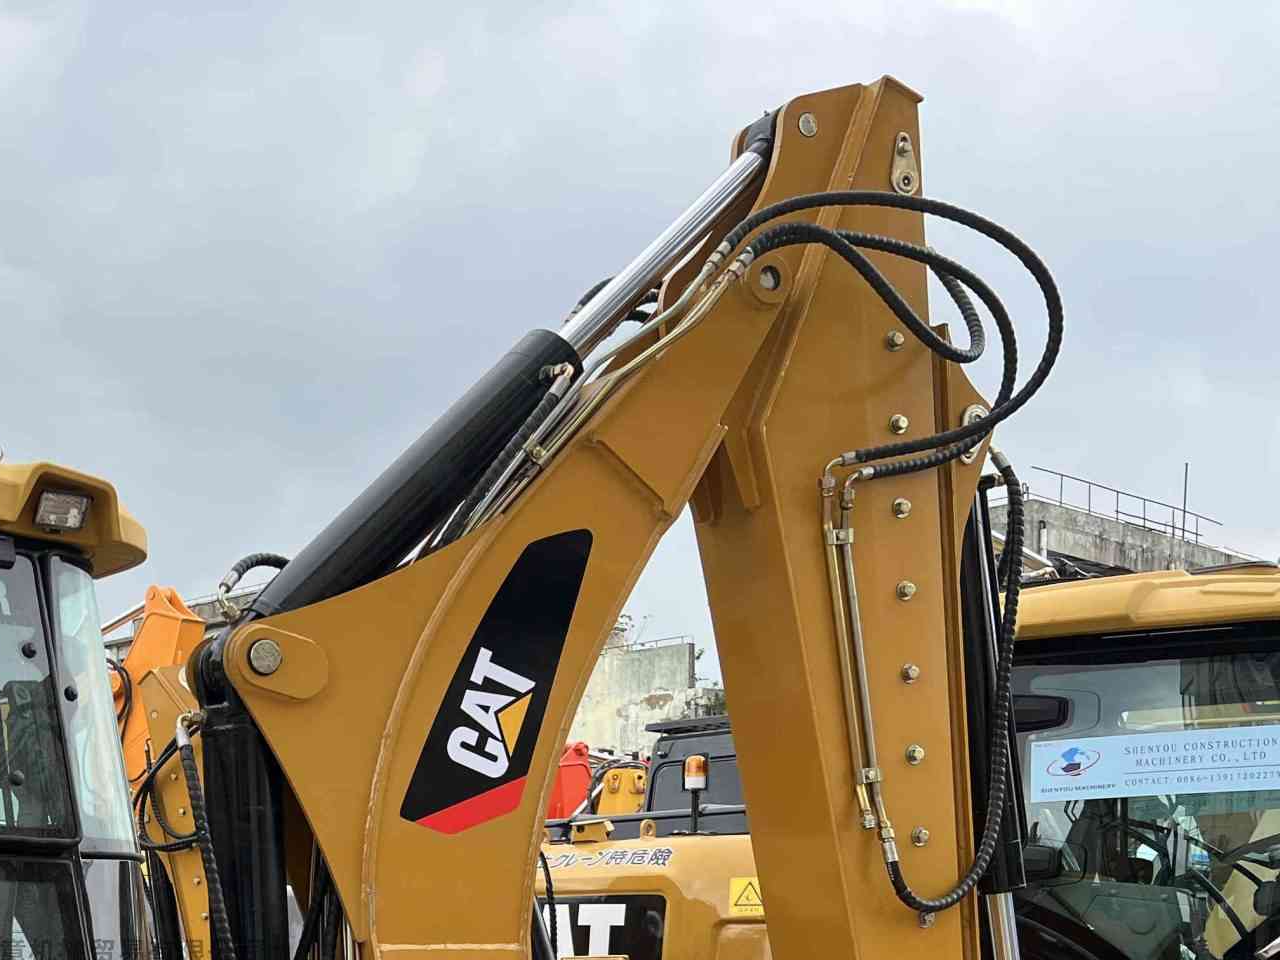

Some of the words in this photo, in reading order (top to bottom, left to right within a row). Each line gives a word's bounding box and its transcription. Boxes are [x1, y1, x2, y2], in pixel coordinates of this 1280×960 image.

[447, 647, 536, 778] CAT
[1124, 743, 1177, 755] SHENYOU
[1184, 737, 1278, 752] CONSTRUCTION
[1135, 755, 1203, 768] MACHINERY
